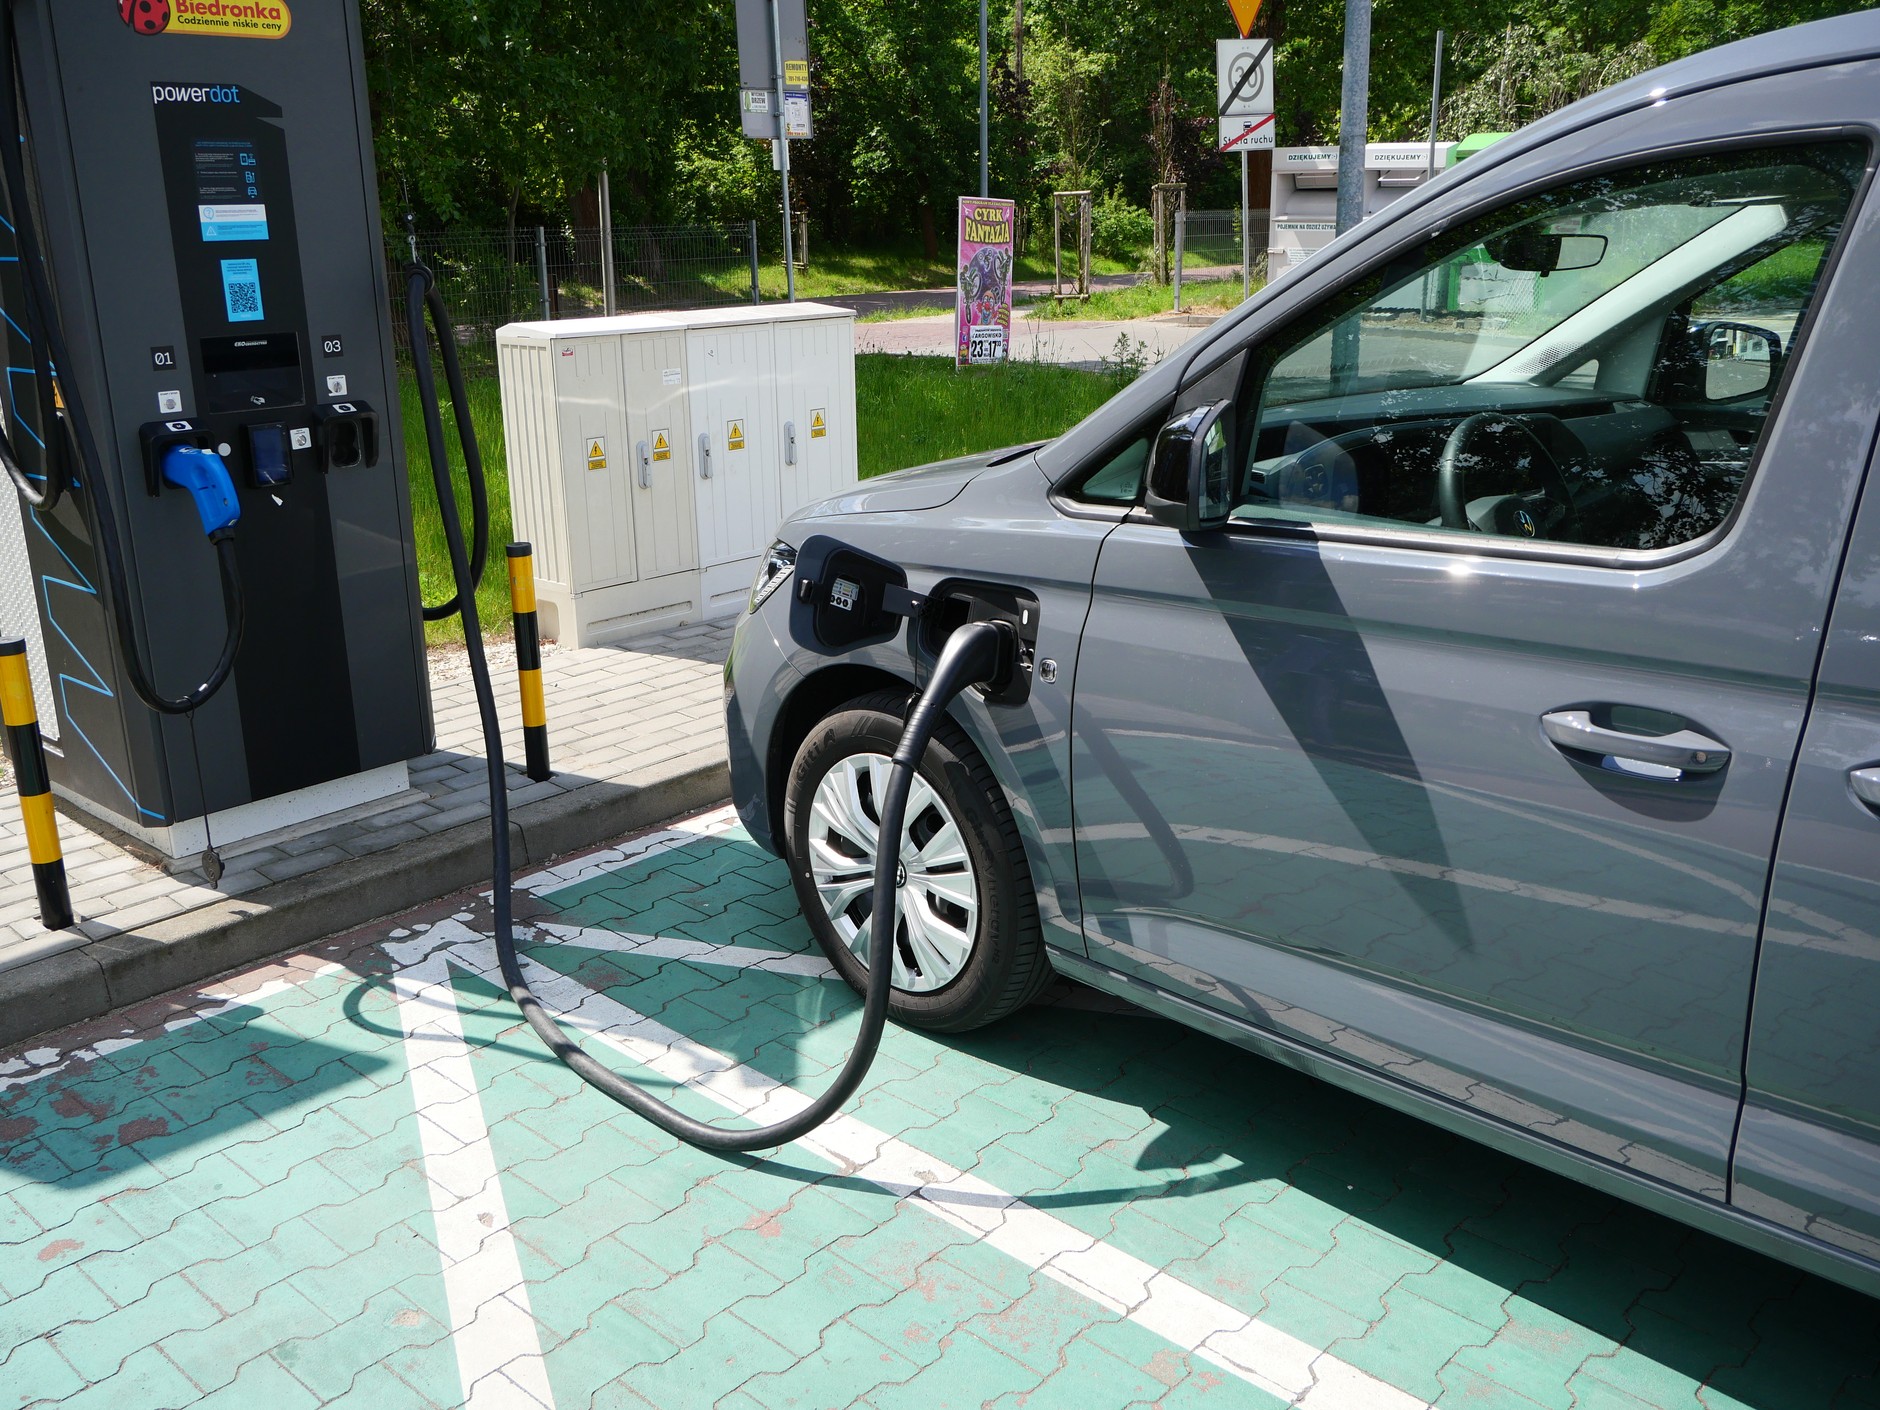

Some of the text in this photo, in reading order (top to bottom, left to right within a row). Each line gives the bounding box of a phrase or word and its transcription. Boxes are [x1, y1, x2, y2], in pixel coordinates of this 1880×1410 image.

[175, 0, 281, 20] Biedronka
[178, 15, 281, 31] Codziennie niskie ceny
[152, 85, 240, 104] powerdot
[1250, 134, 1273, 144] ruchu
[974, 207, 1003, 222] CYRK
[965, 217, 1010, 243] FANTAZJA
[324, 339, 341, 353] 03
[971, 340, 983, 358] 23
[155, 351, 173, 365] 01
